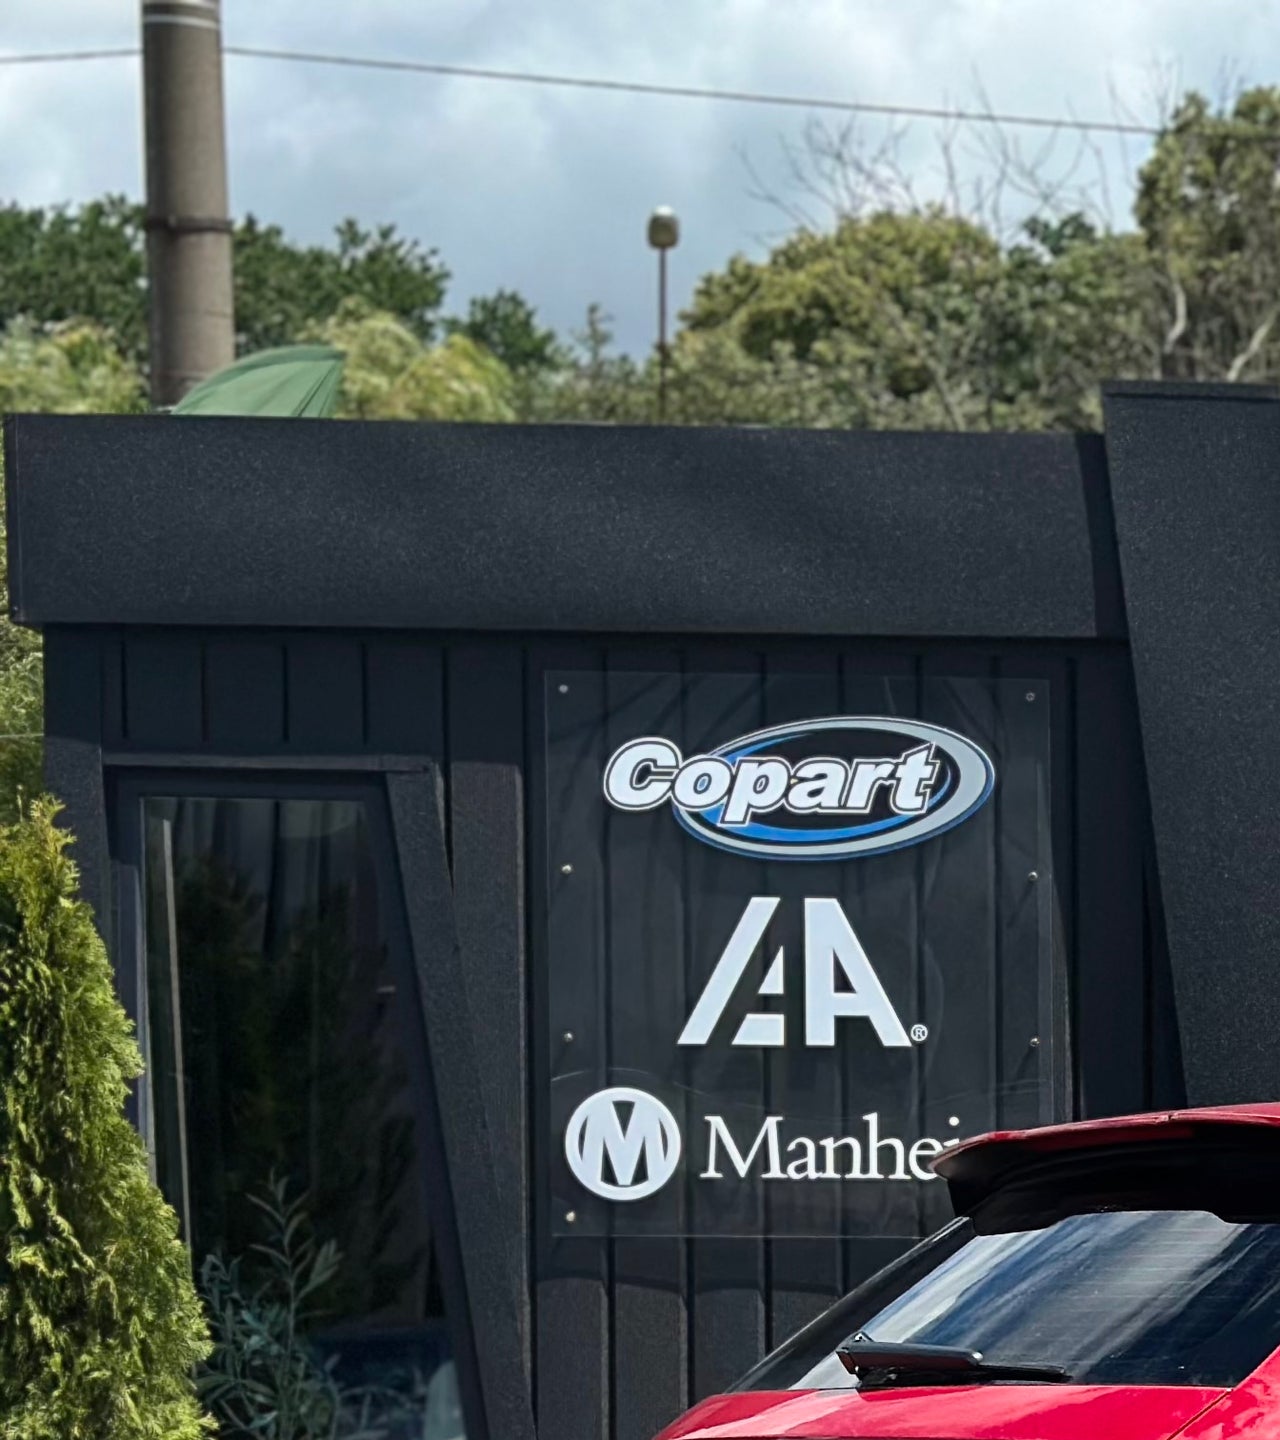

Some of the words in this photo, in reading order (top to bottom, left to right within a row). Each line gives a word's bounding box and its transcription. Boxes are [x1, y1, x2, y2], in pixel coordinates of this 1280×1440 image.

[604, 736, 940, 826] Copart
[573, 1094, 675, 1195] M
[699, 1111, 960, 1182] Manhe
